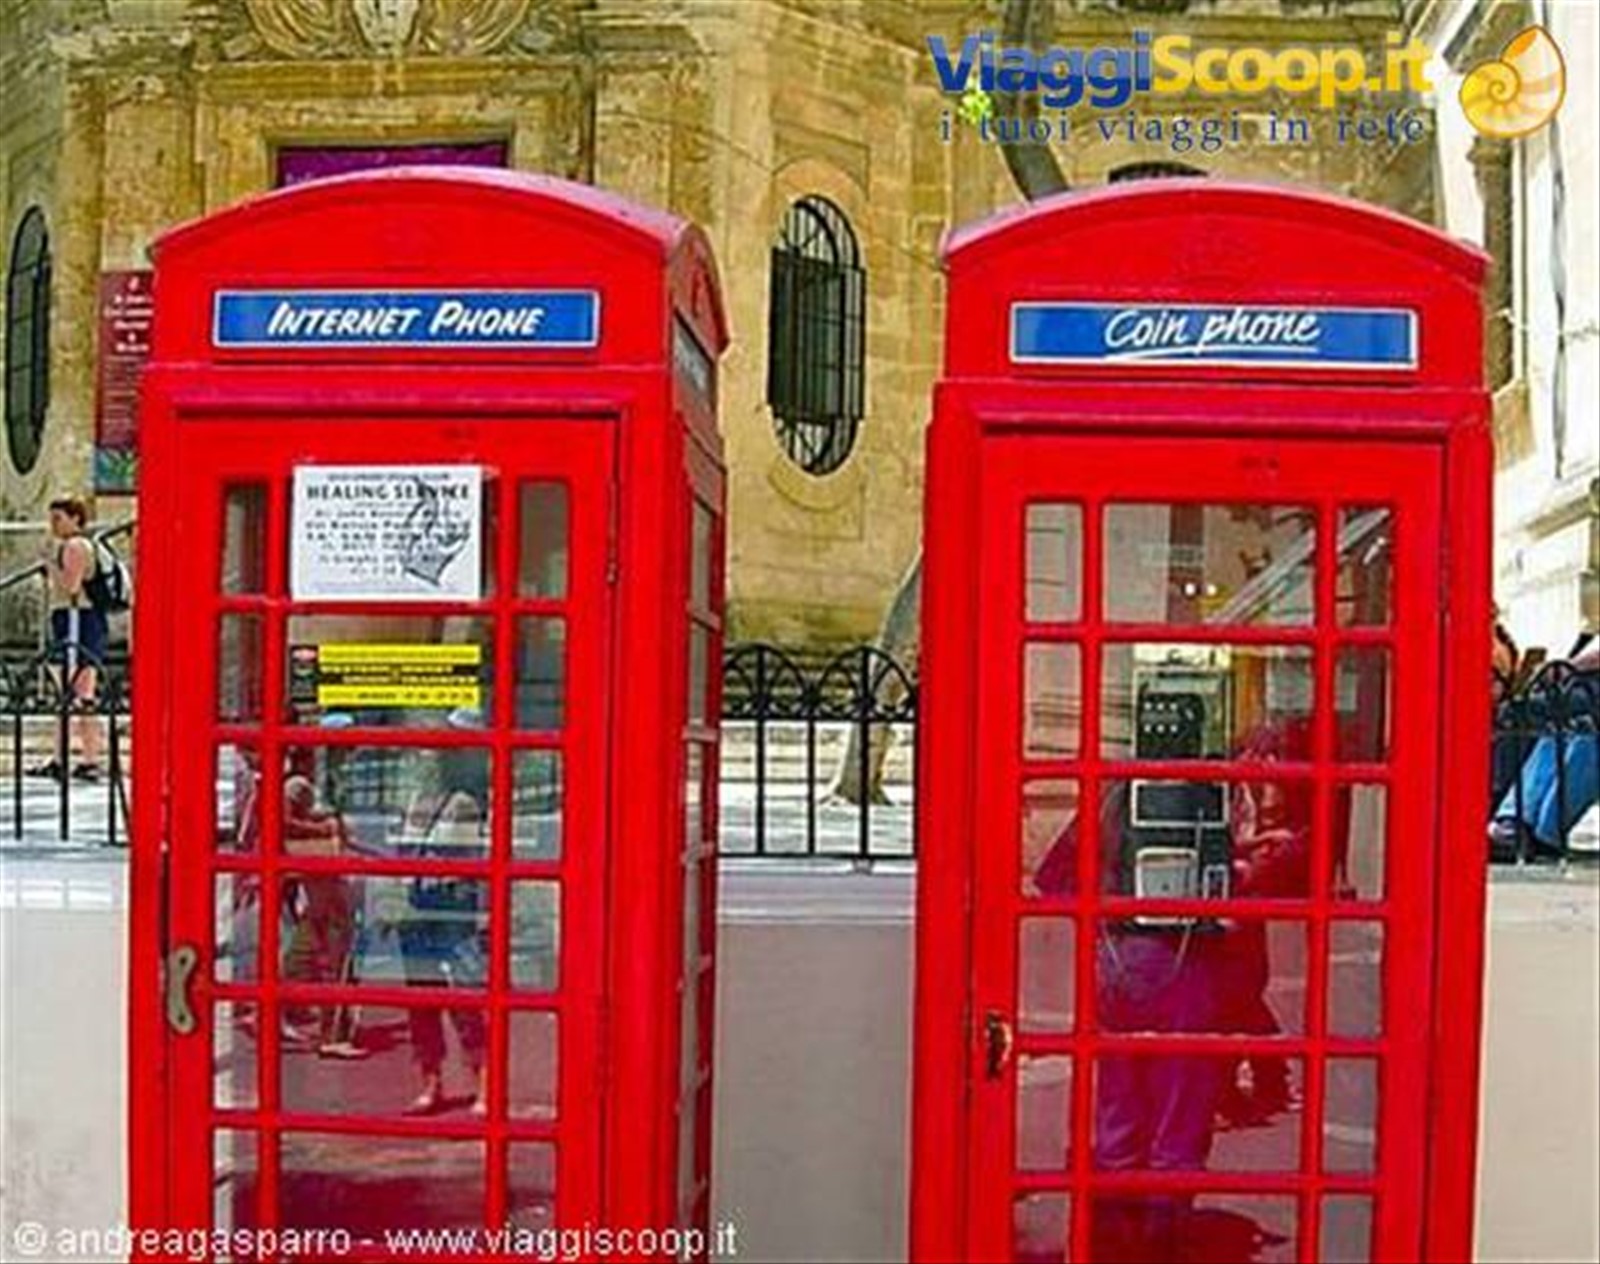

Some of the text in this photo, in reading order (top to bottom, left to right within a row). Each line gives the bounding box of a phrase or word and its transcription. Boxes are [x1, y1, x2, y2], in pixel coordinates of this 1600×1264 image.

[267, 299, 545, 336] INTERNET PHONE
[1104, 307, 1320, 355] Coin phone
[306, 484, 389, 500] HEALING
